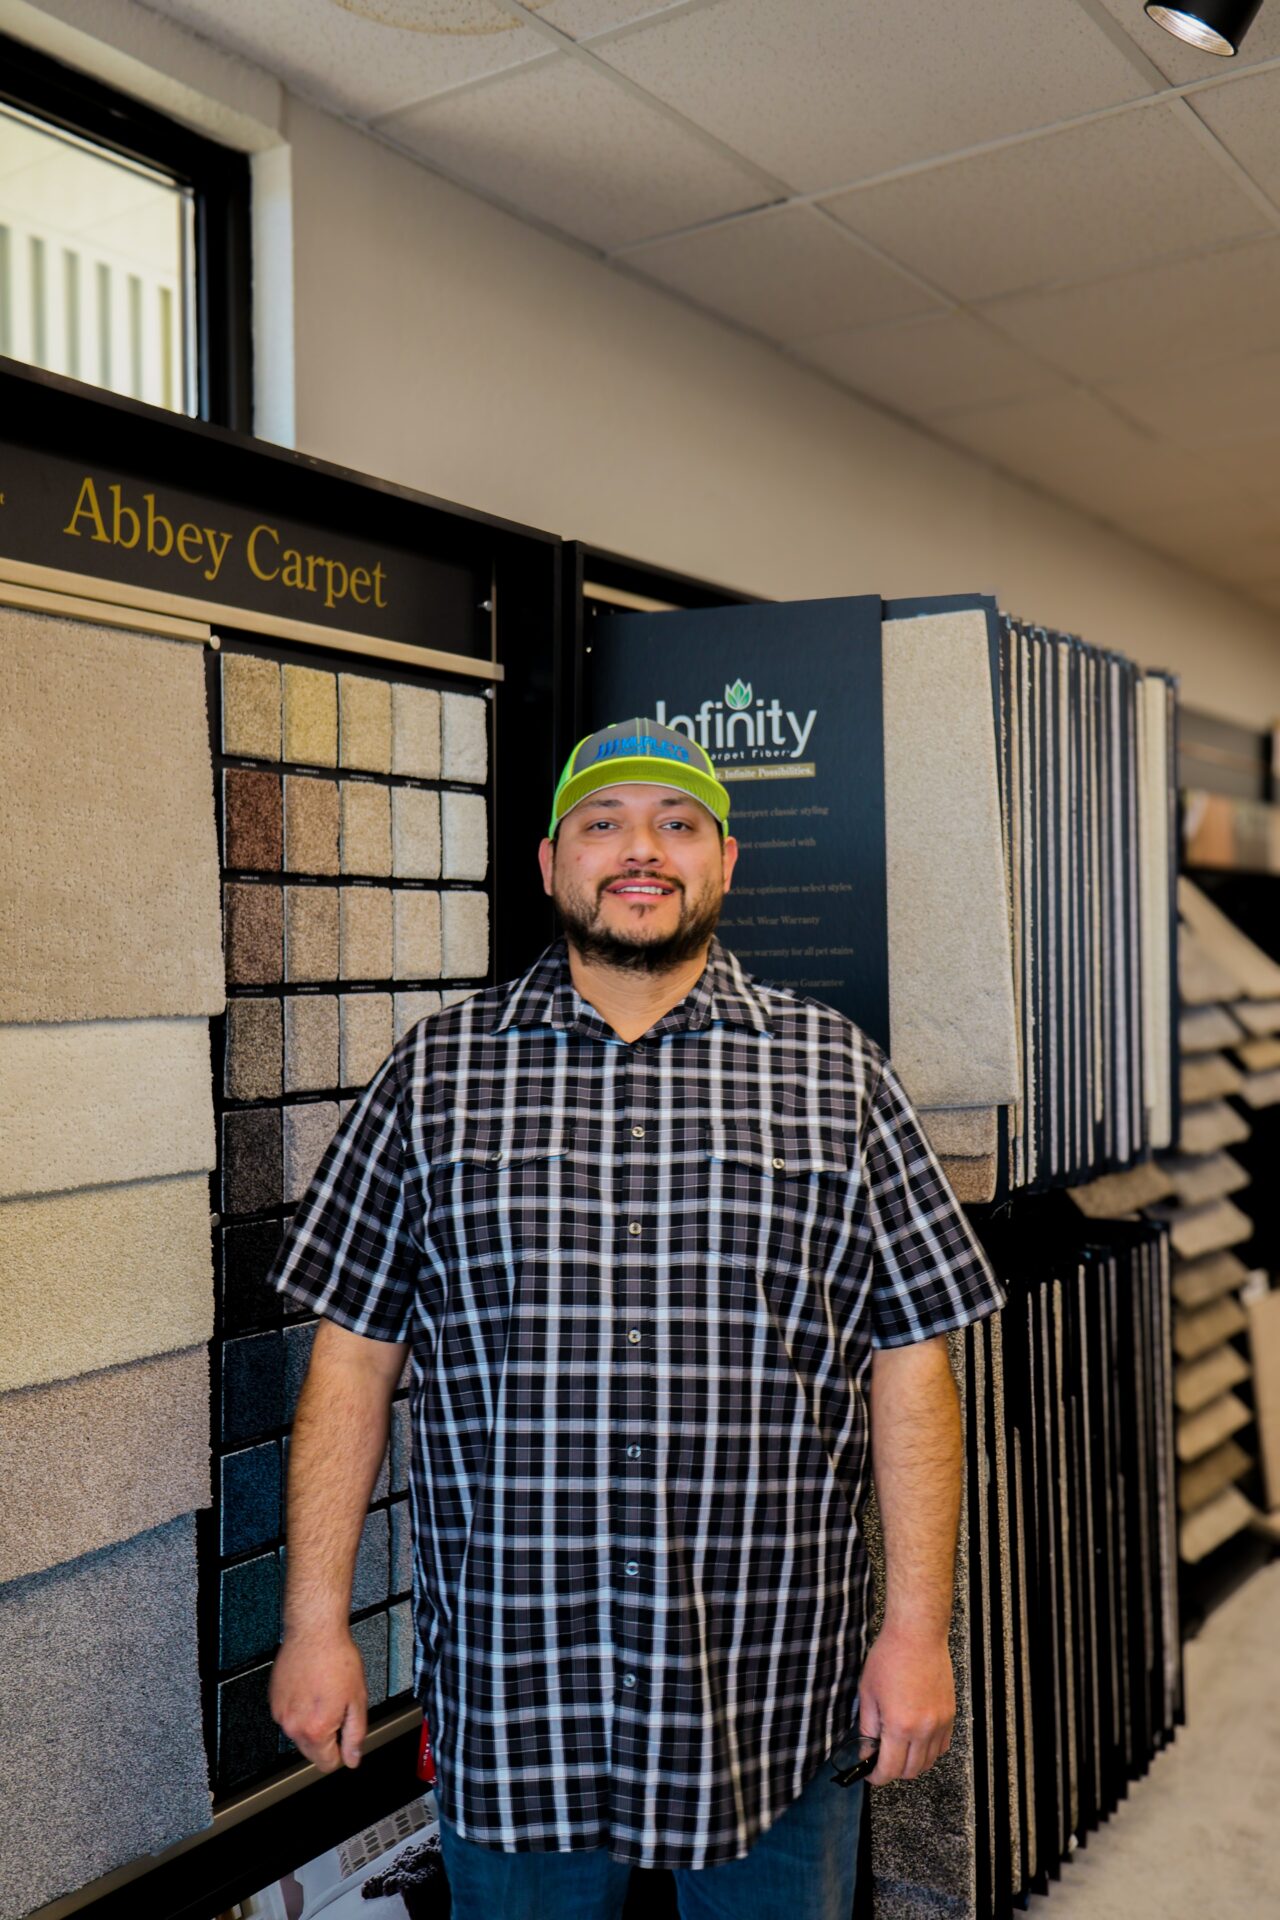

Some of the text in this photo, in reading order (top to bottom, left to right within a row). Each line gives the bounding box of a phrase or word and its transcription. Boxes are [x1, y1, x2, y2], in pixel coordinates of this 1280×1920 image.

[63, 477, 388, 608] Abbey Carpet
[655, 699, 818, 759] Infinity
[710, 751, 745, 761] arpet
